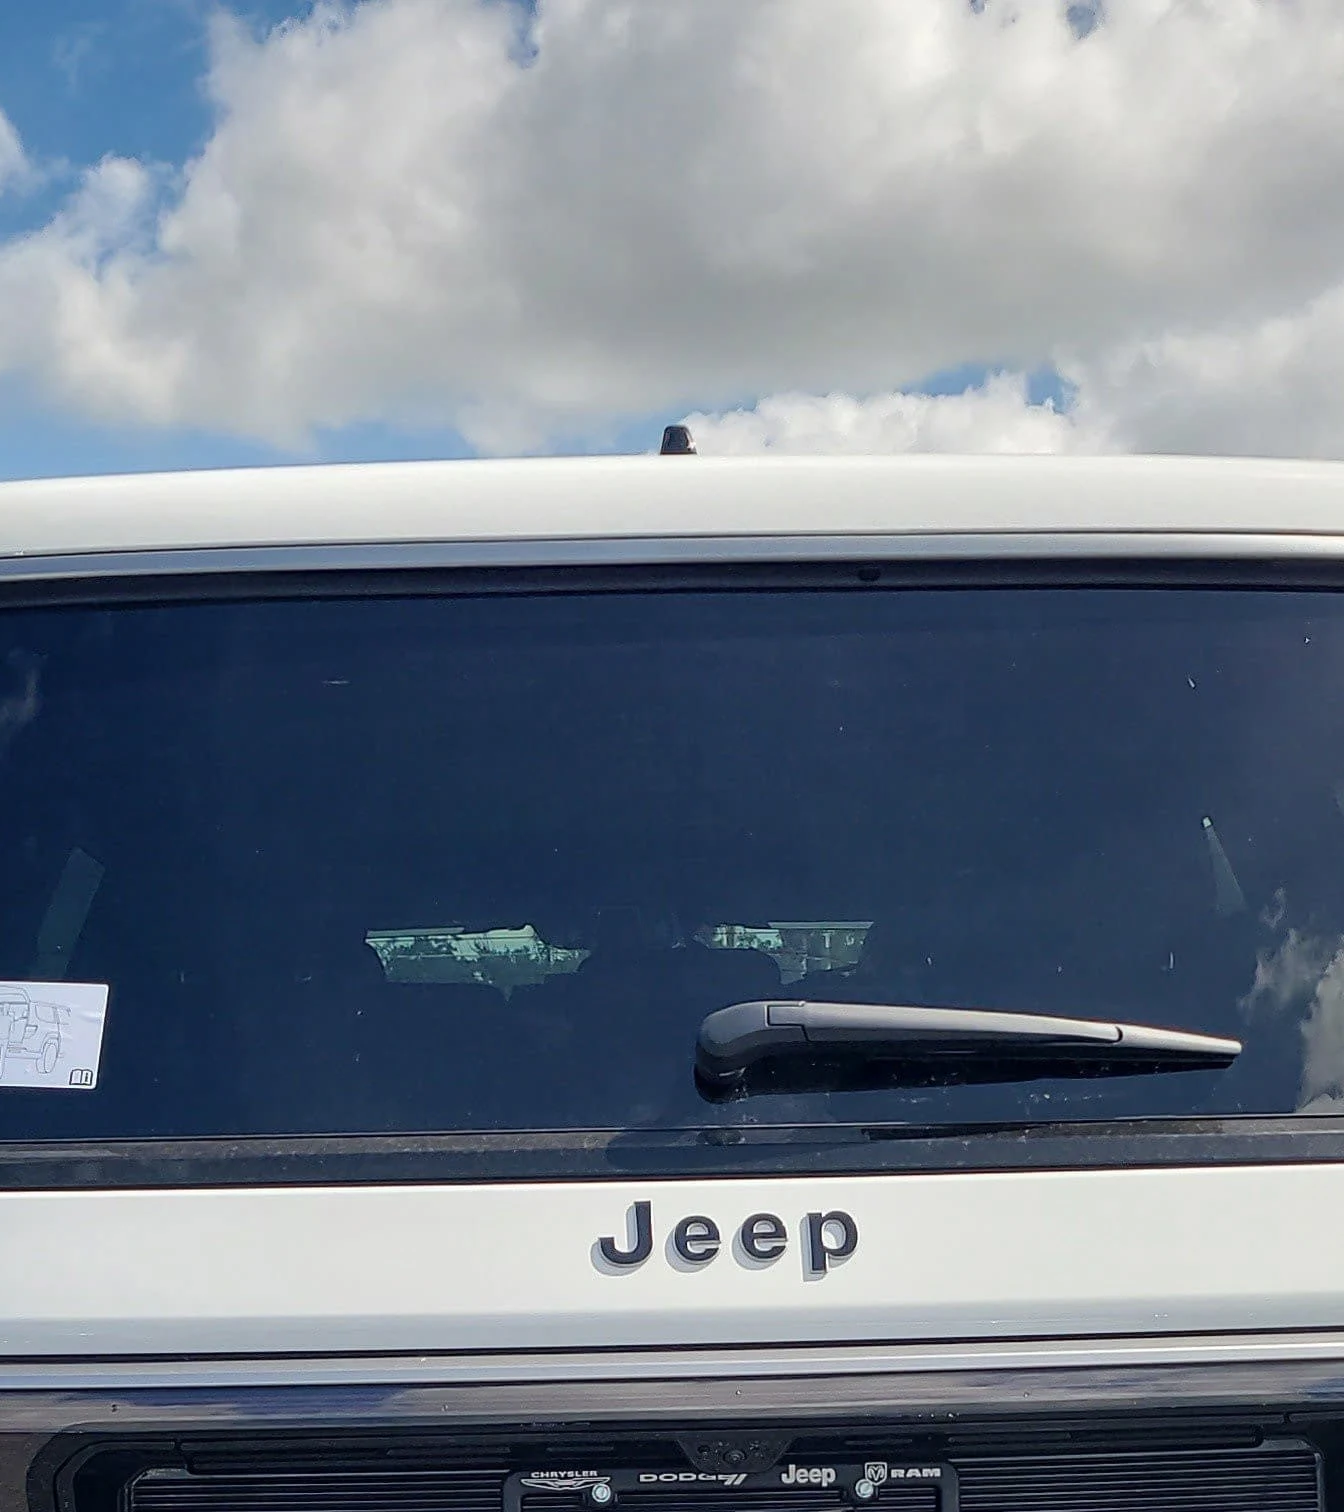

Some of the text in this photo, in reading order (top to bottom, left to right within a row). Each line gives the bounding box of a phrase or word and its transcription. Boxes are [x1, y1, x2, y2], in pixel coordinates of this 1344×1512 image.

[593, 1200, 859, 1280] Jeep
[531, 1470, 598, 1478] CHRYSLER
[781, 1464, 836, 1487] Jeep
[890, 1468, 942, 1478] RAM
